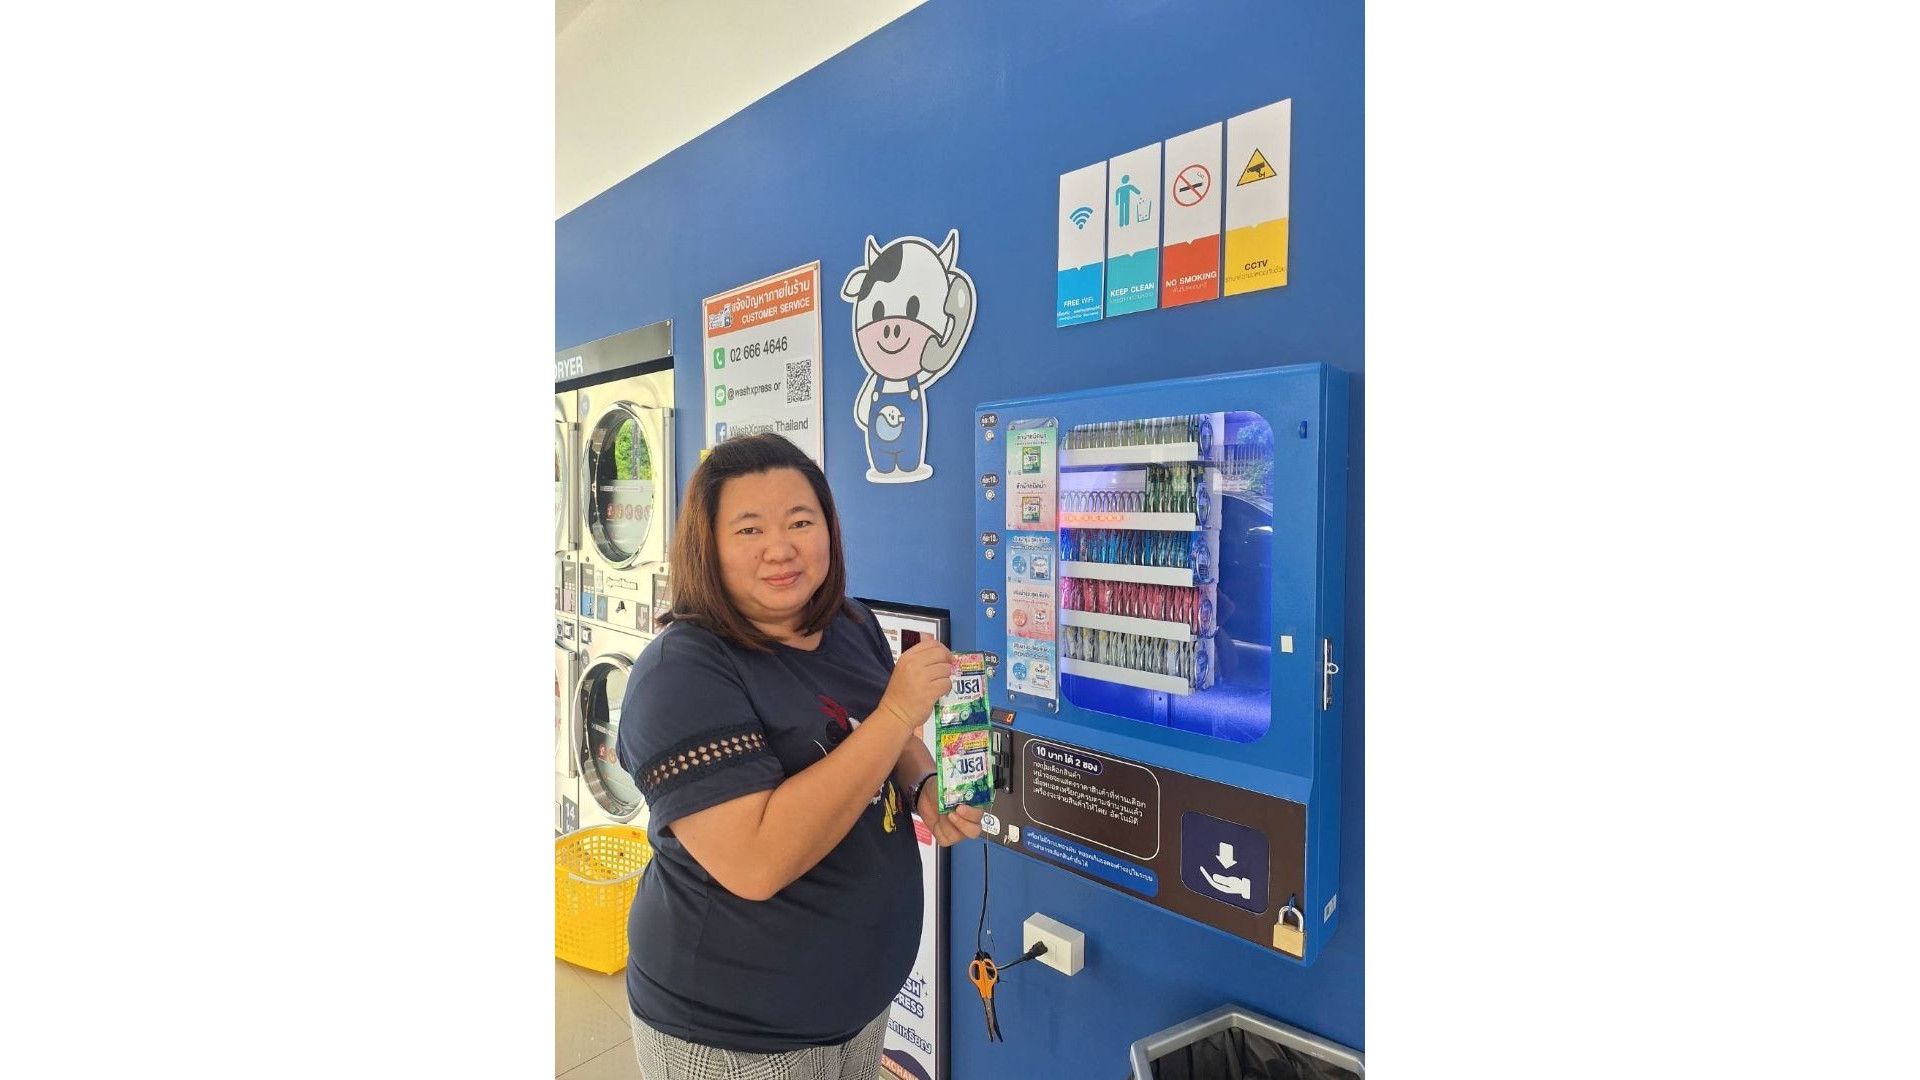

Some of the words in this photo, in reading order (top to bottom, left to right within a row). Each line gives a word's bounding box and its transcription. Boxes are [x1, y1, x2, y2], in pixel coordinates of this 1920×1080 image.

[1244, 259, 1268, 271] CCTV
[1165, 279, 1177, 288] NO
[1179, 271, 1217, 285] SMOKING
[1110, 288, 1128, 298] KEEP
[1131, 281, 1155, 293] CLEAN
[741, 306, 778, 324] CUSTOMER
[780, 296, 811, 313] SERVICE
[1063, 298, 1080, 307] FREE
[730, 347, 742, 363] 02
[743, 342, 761, 360] 666
[762, 336, 788, 355] 4646
[773, 381, 781, 391] or
[775, 418, 809, 433] Thailand
[1036, 745, 1047, 757] 10
[1048, 752, 1063, 763] บาท
[1064, 751, 1074, 765] ได้
[1075, 759, 1081, 768] 2
[1083, 761, 1099, 773] ซอง
[903, 977, 921, 998] SH
[887, 1017, 933, 1054] ลกเหรียญ
